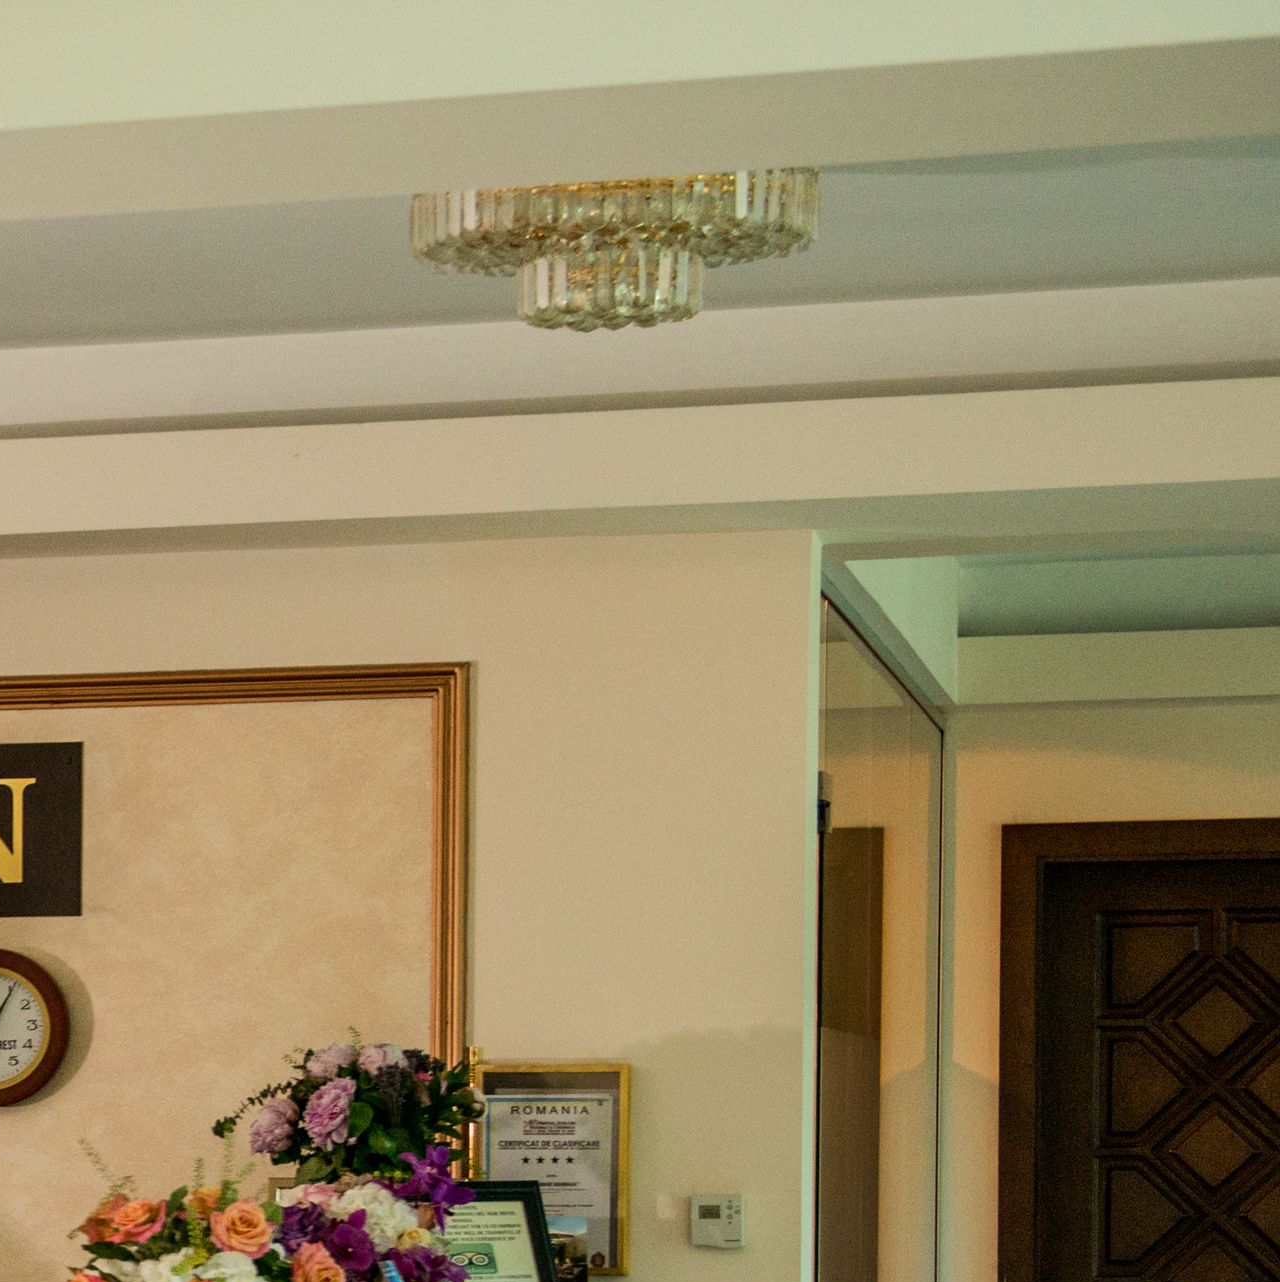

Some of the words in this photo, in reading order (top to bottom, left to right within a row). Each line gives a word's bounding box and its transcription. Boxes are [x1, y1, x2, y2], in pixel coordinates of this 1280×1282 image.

[21, 999, 31, 1010] 2
[27, 1019, 38, 1031] 3
[23, 1039, 32, 1049] 4
[8, 1056, 19, 1066] 5
[510, 1105, 590, 1115] ROMANIA
[498, 1140, 539, 1148] CERTIFICAT
